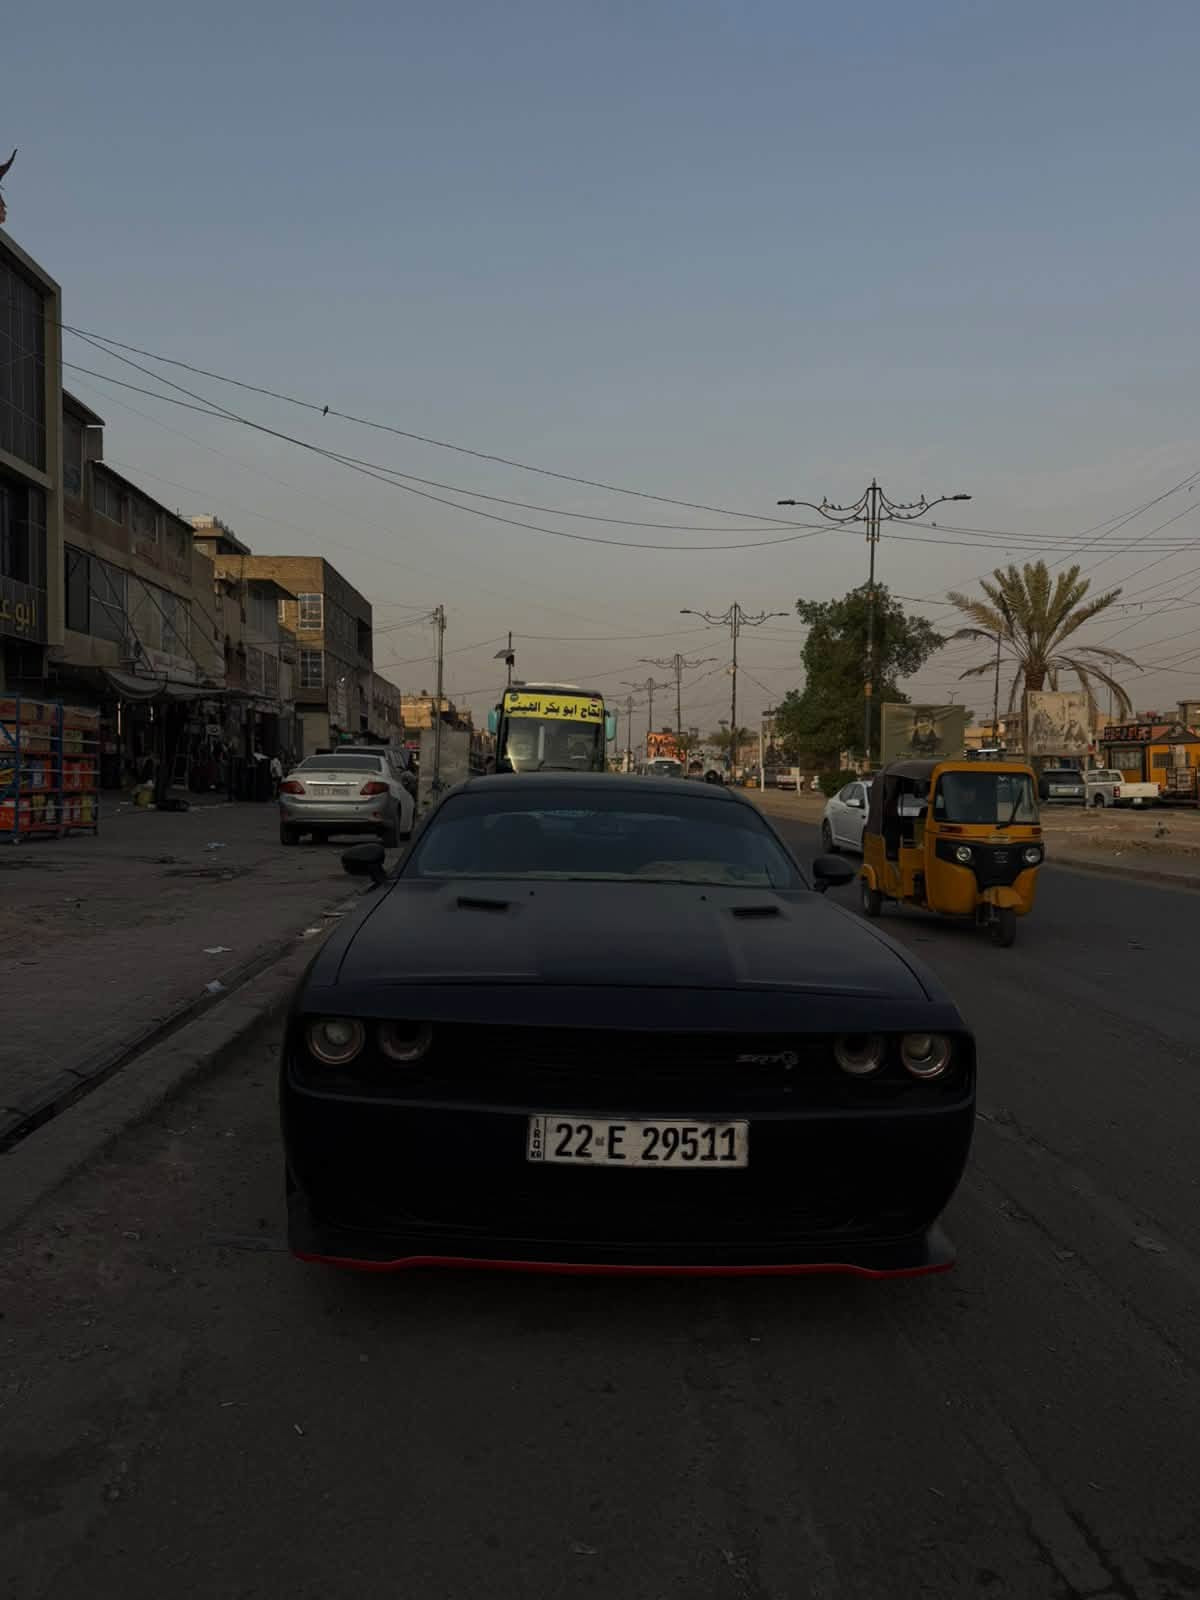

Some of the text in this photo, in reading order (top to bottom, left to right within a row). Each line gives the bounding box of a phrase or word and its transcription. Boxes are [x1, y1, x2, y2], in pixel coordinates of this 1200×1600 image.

[543, 702, 560, 715] بكر
[562, 704, 577, 717] ابو
[555, 1124, 737, 1161] 22 E 29511
